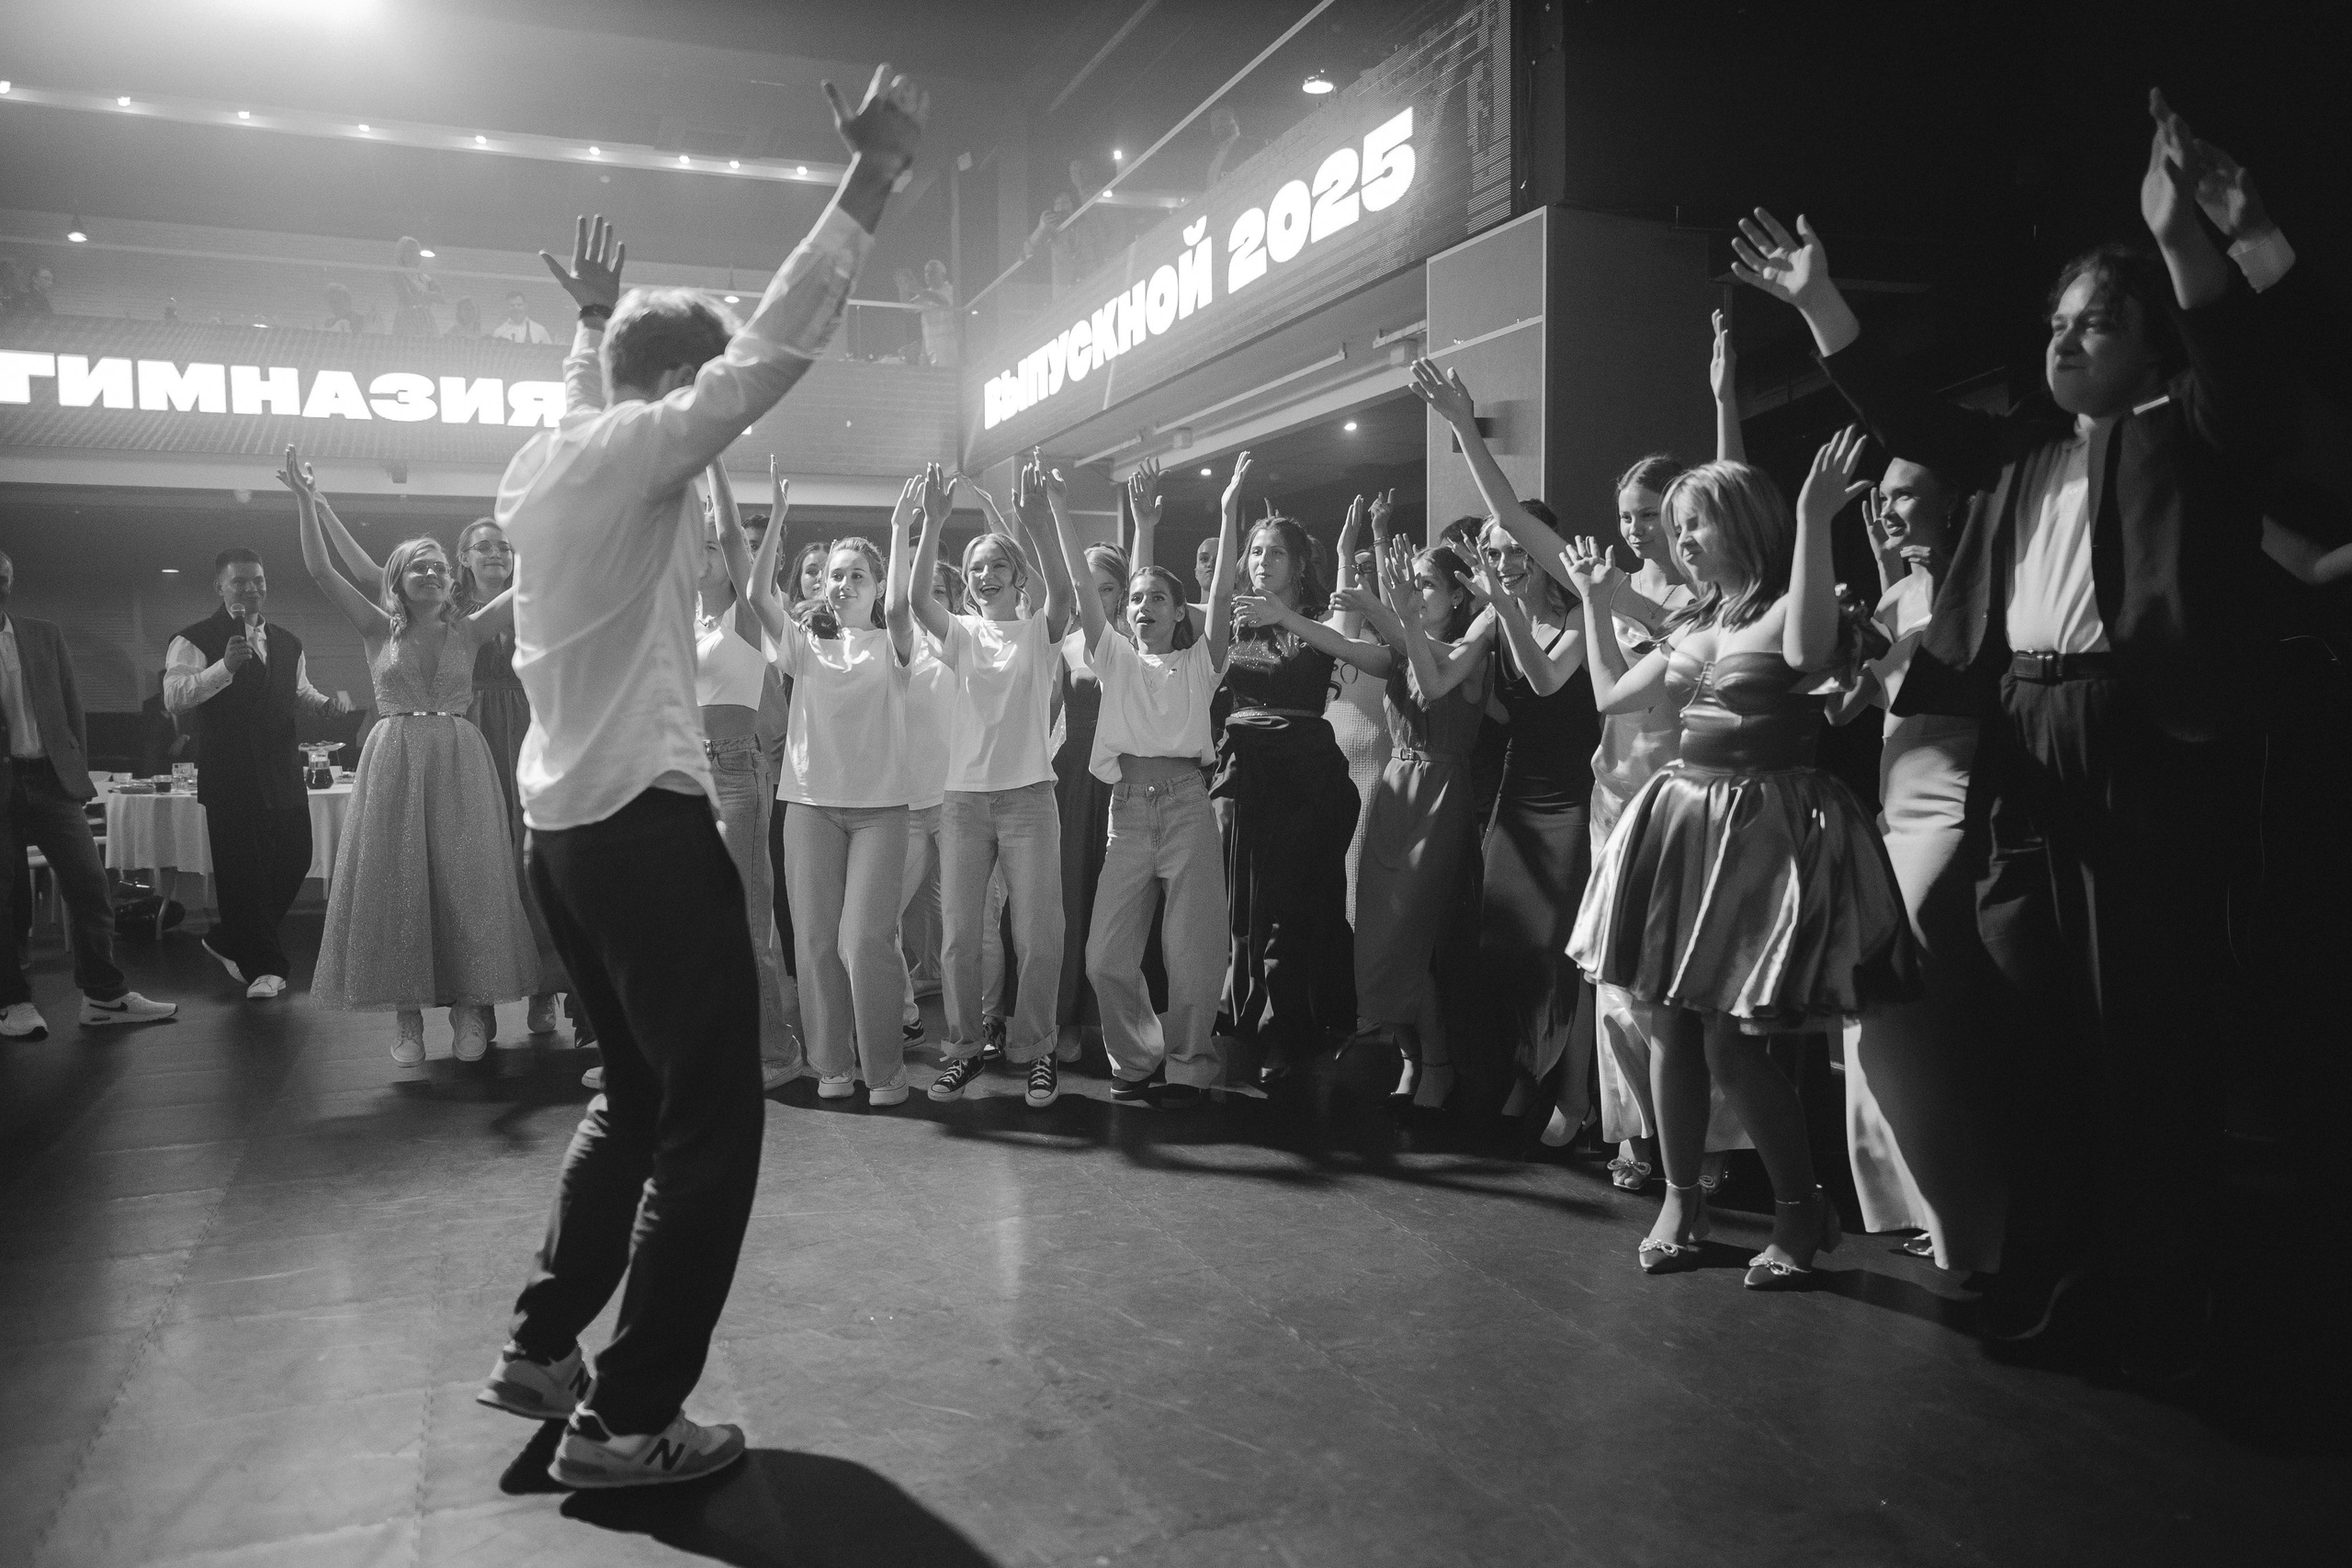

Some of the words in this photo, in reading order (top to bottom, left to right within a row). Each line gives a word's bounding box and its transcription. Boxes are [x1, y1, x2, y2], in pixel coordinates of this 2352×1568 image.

[984, 215, 1213, 430] ВЫПУСКНОЙ
[1227, 107, 1416, 294] 2025
[0, 349, 567, 428] ГИМНАЗИЯ
[644, 1438, 686, 1472] N
